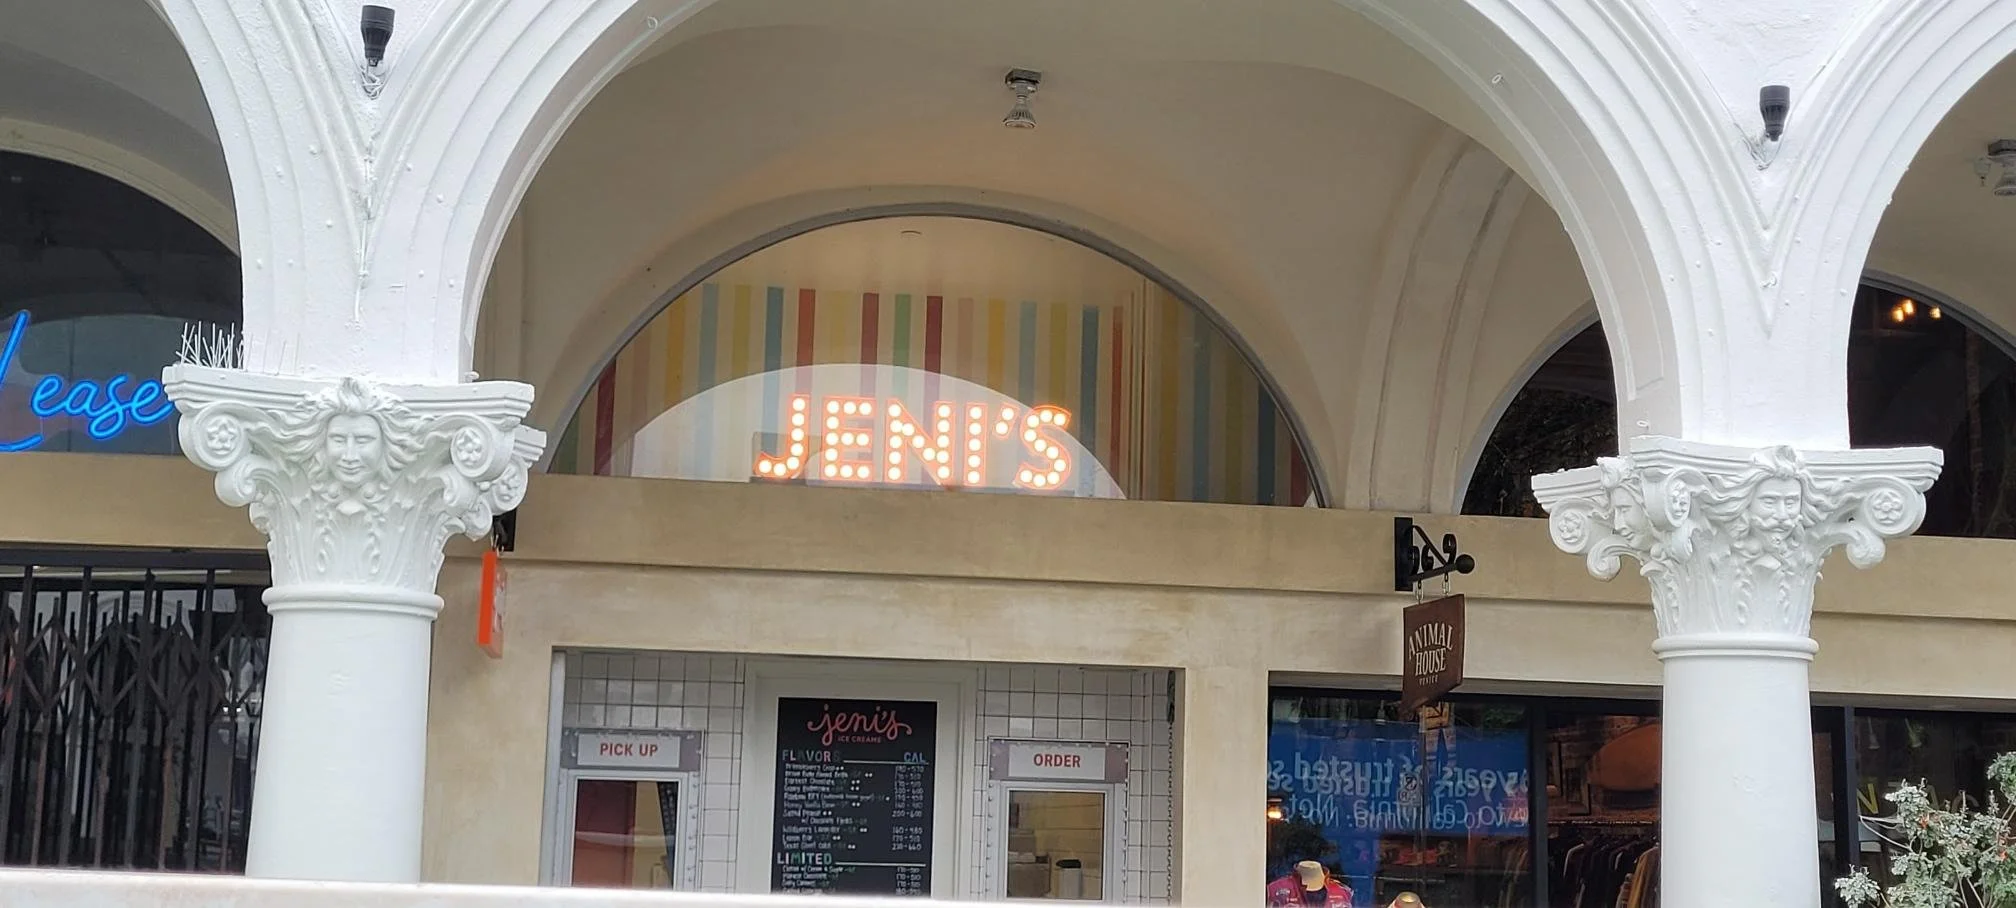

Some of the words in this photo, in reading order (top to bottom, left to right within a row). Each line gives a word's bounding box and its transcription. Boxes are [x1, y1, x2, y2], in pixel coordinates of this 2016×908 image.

[752, 394, 1073, 490] JENI'S
[1408, 622, 1454, 660] ANIMAL
[1415, 647, 1447, 676] HOUSE
[807, 704, 913, 746] jeni's
[838, 735, 849, 743] ICE
[851, 736, 882, 744] CREAMS
[600, 742, 633, 756] PICK
[639, 743, 658, 757] UP
[903, 752, 927, 763] CAL
[1033, 753, 1081, 768] ORDER
[776, 851, 833, 865] LIMITED
